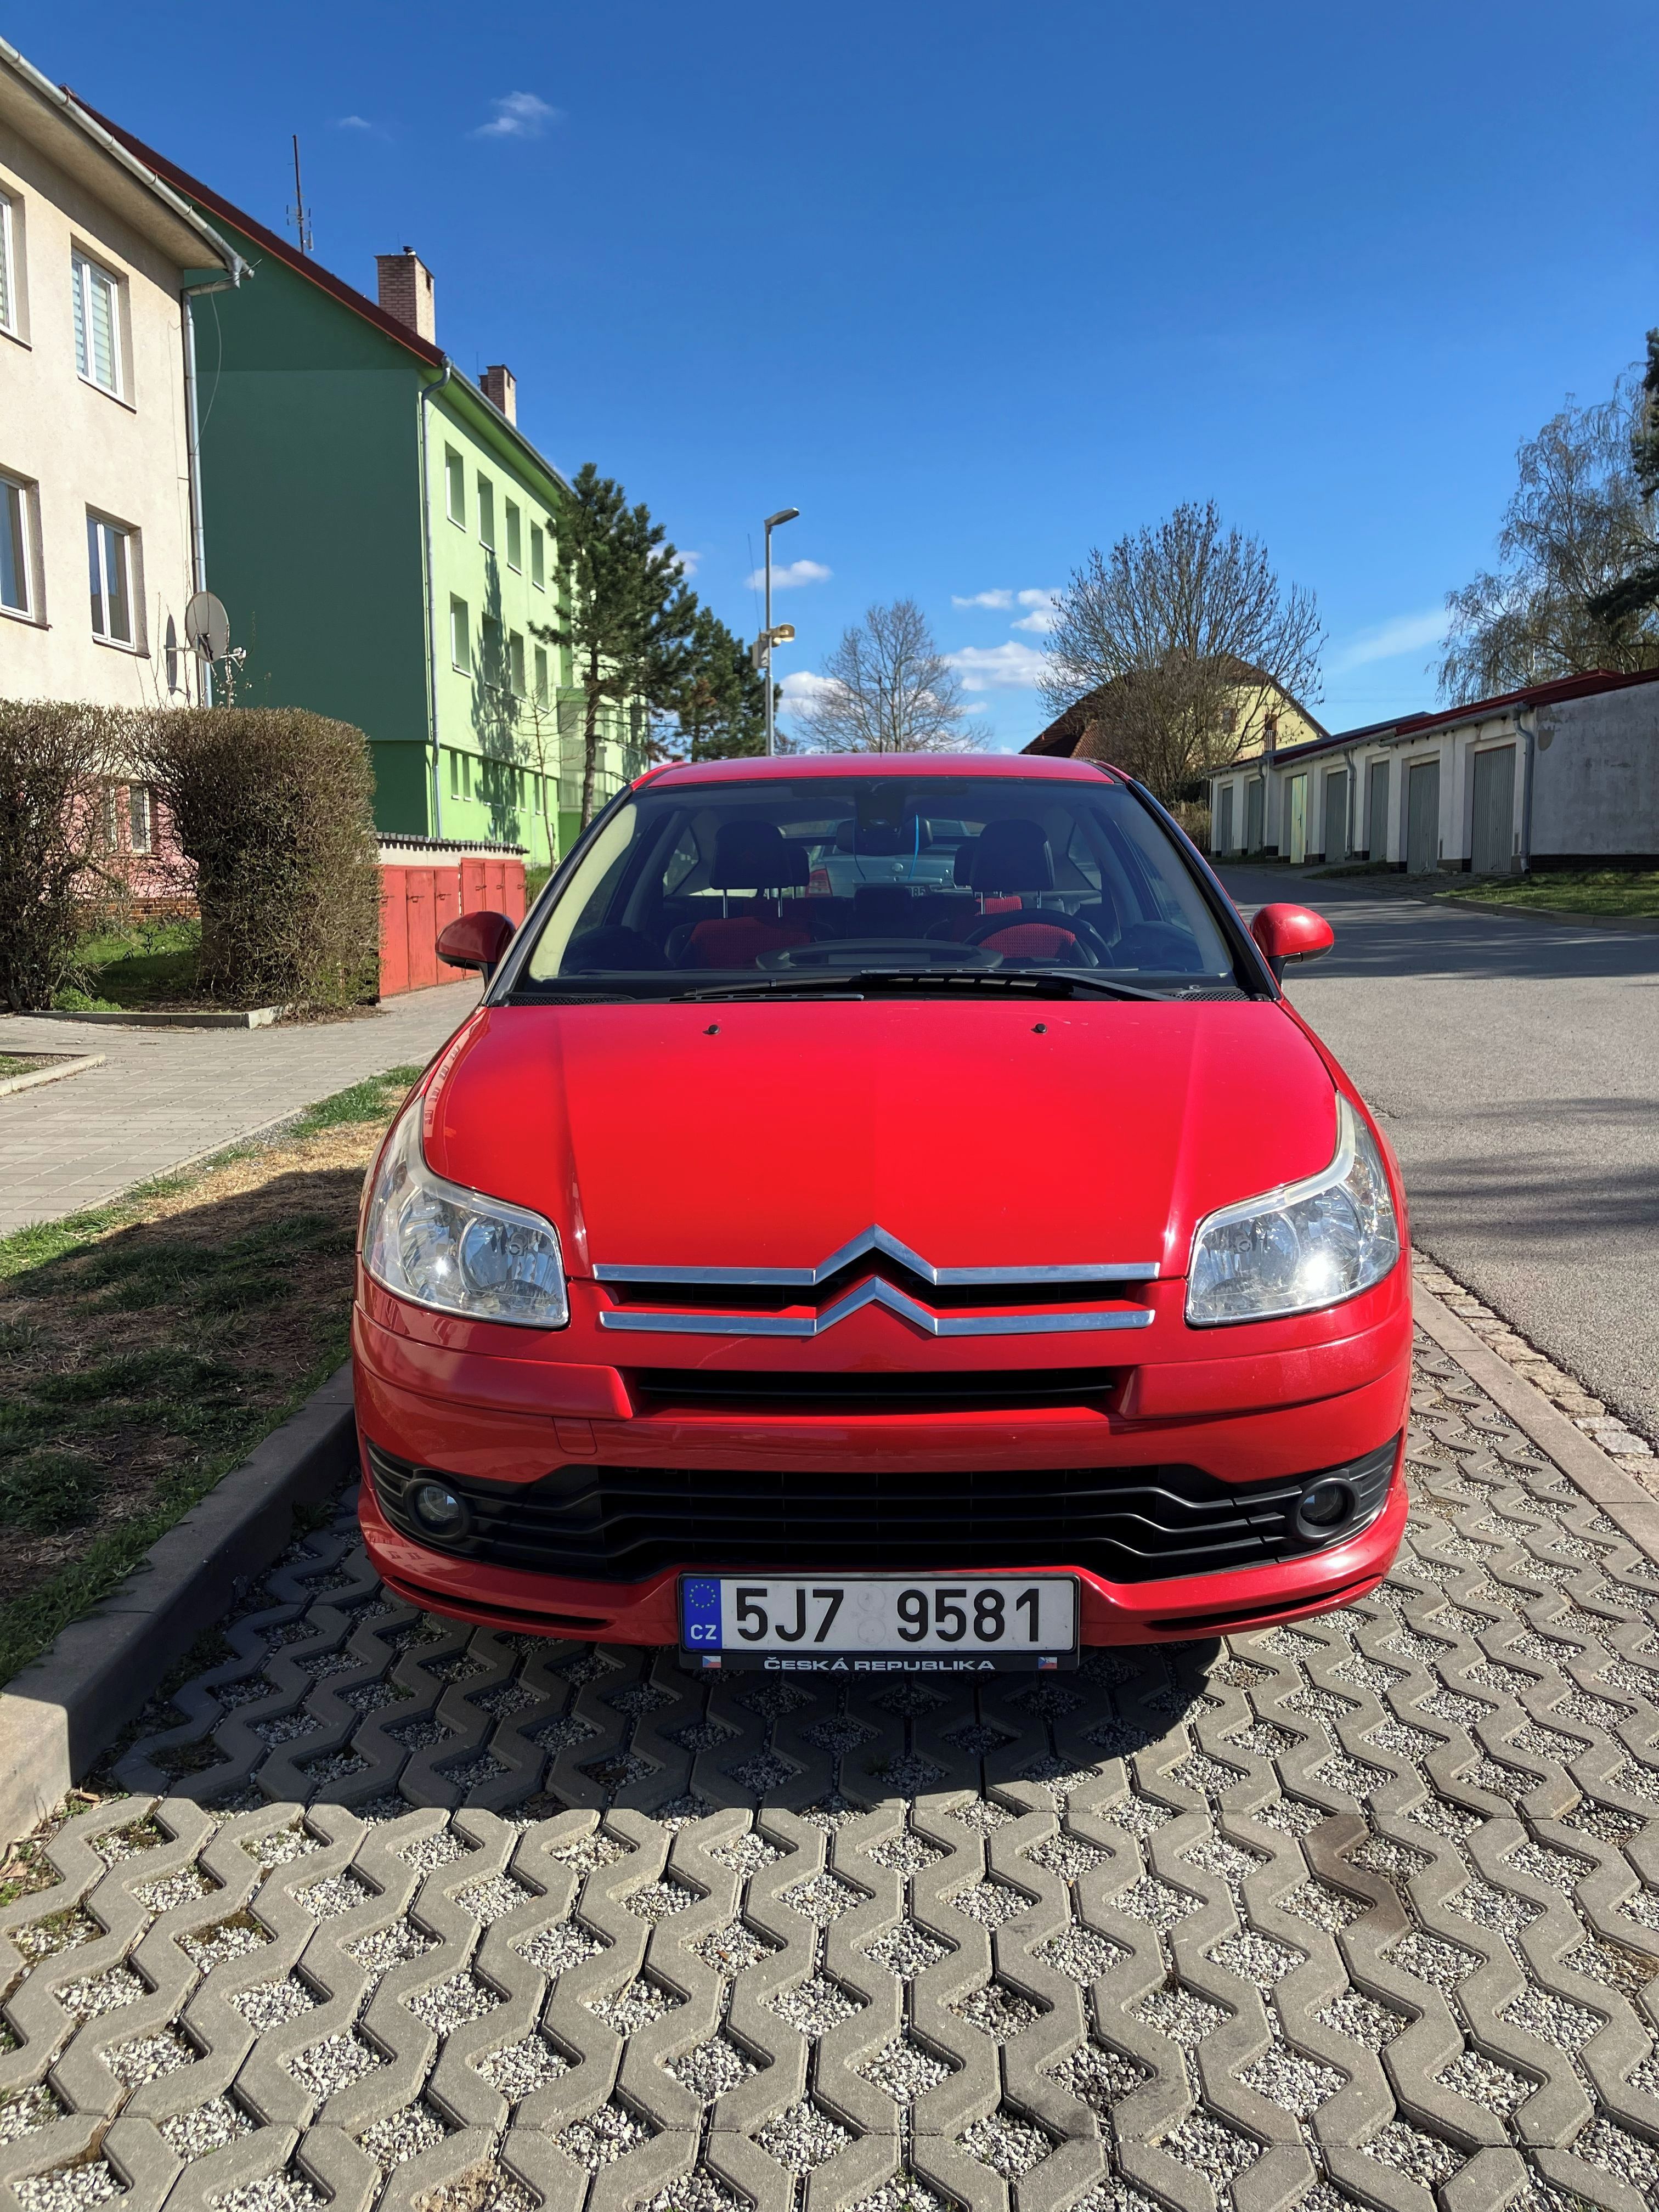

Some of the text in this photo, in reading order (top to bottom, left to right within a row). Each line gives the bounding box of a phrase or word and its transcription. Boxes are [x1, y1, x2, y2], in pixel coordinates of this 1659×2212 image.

[690, 1587, 1040, 1643] CZ 5J7 9581
[764, 1657, 996, 1671] ČESKÁ REPUBLIKA
